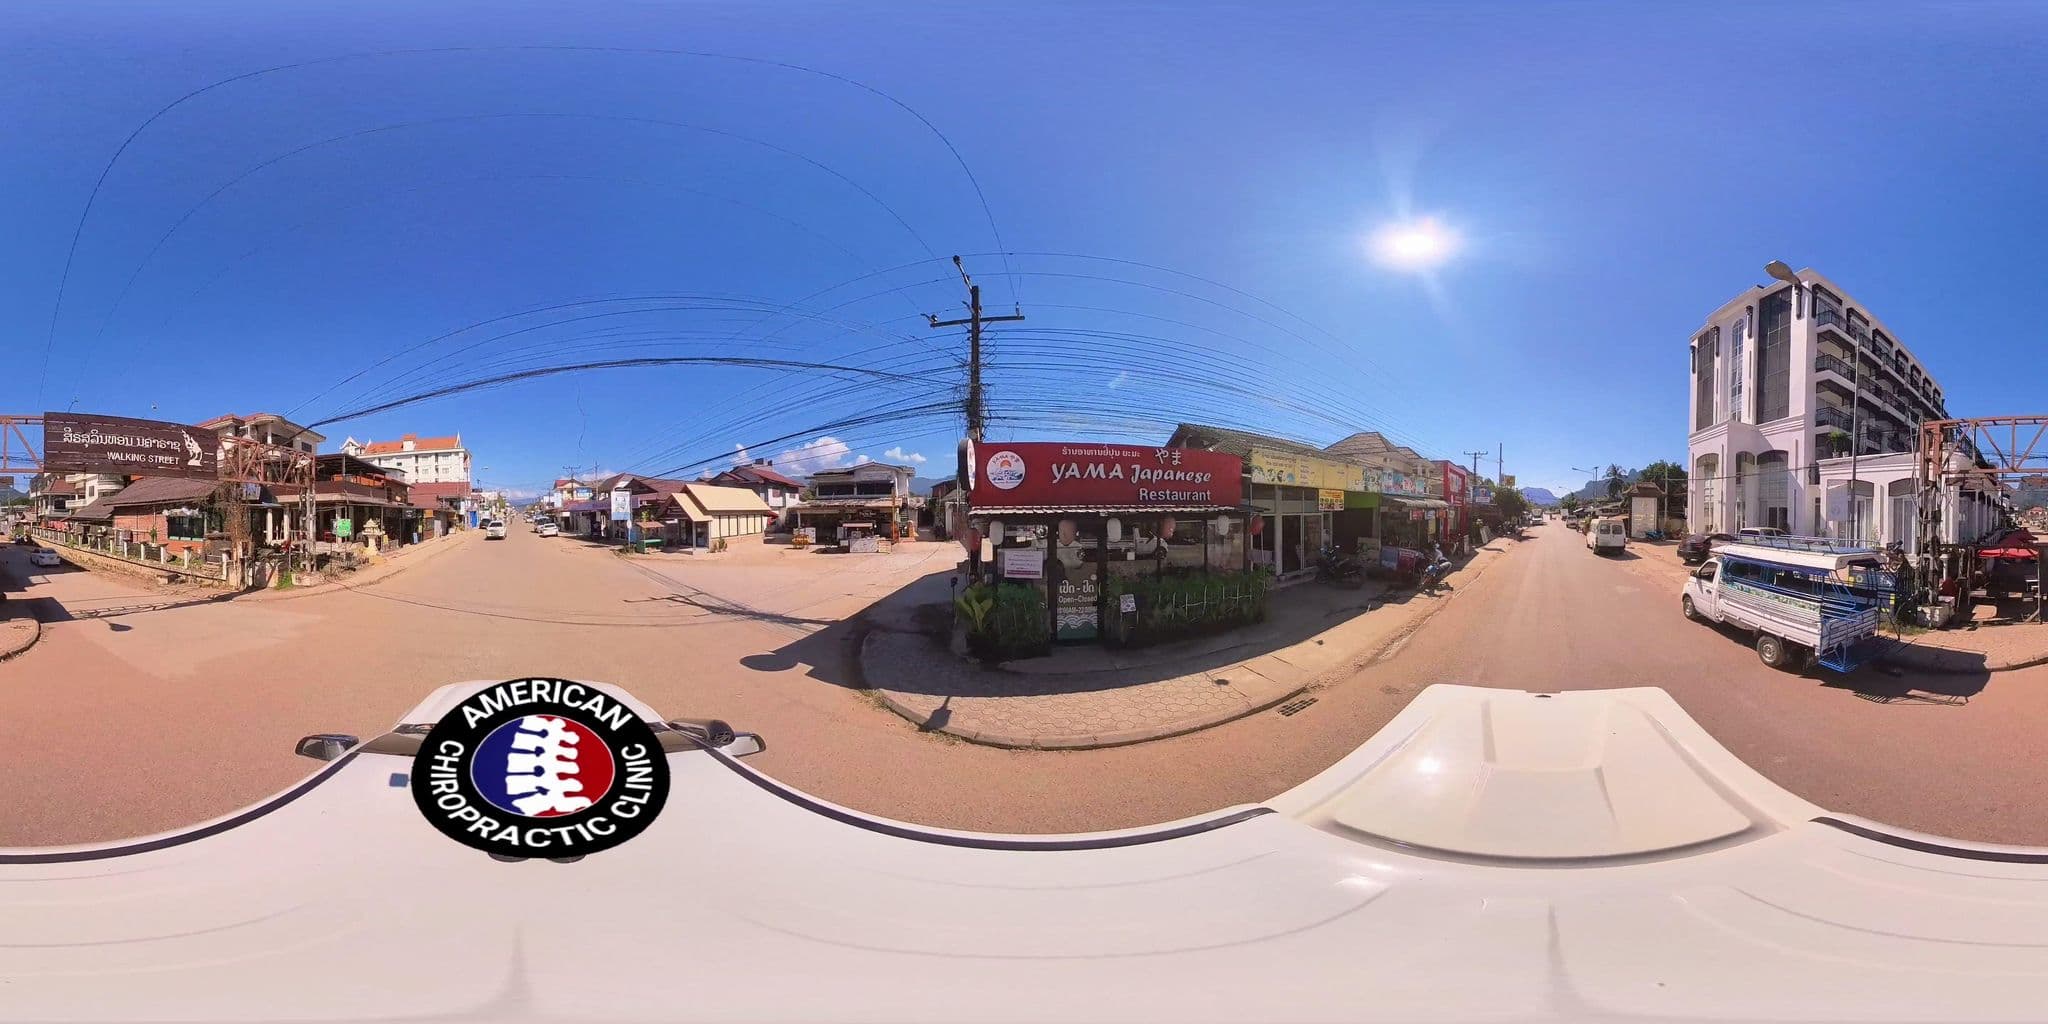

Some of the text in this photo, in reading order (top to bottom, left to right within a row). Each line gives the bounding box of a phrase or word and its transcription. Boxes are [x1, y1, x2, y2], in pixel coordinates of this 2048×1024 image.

[107, 451, 179, 465] WALKING STREET
[1155, 448, 1182, 465] やま
[1051, 462, 1212, 484] YAMA Japanese
[1139, 488, 1212, 501] Restaurant
